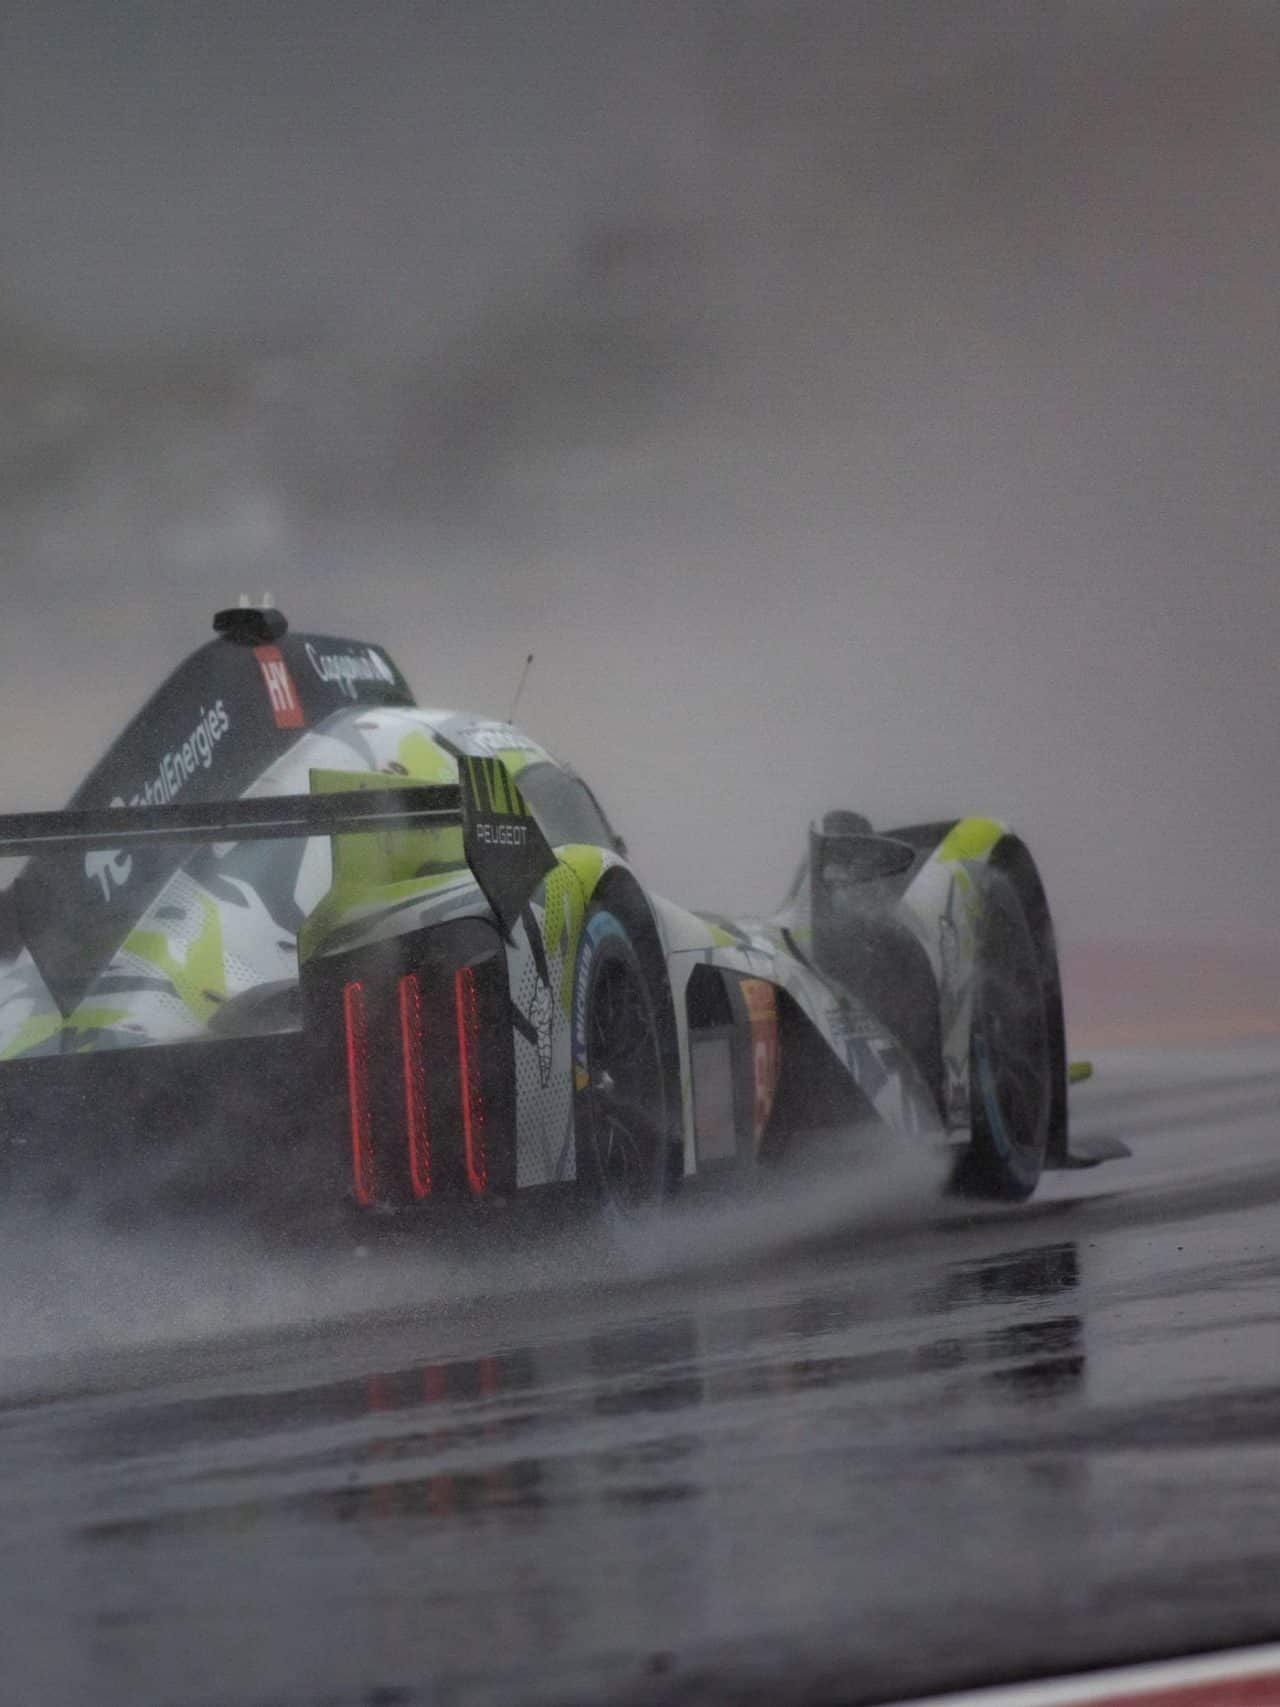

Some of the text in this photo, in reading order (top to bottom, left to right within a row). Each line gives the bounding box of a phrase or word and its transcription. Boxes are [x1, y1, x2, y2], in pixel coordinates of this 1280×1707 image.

[260, 660, 295, 712] HY
[129, 699, 230, 807] talEnergies
[476, 823, 528, 845] PEUGEOT
